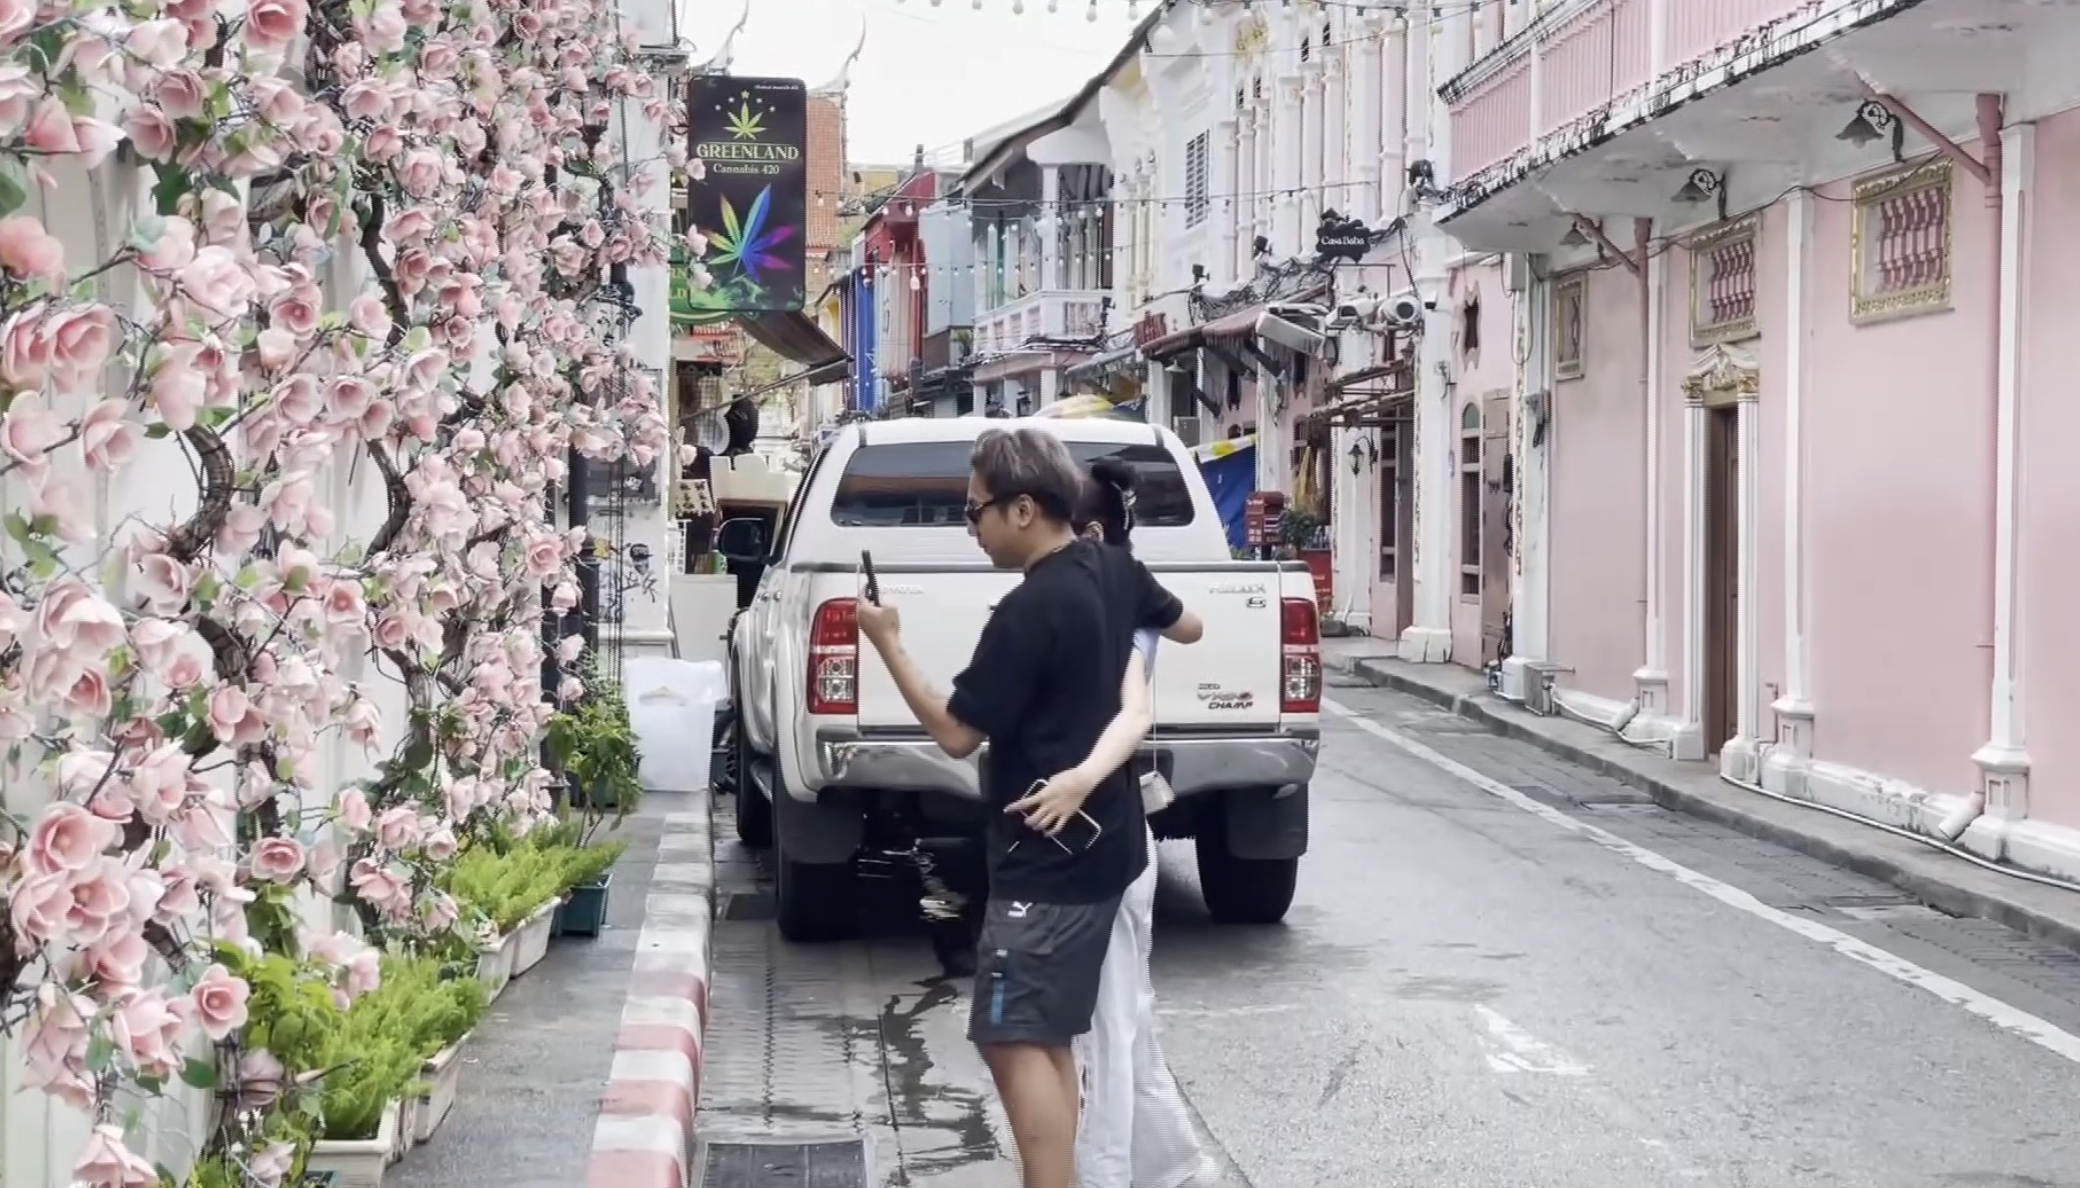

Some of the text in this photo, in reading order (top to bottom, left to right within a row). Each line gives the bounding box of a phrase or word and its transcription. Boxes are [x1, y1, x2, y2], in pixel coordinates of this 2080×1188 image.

[696, 143, 800, 160] GREENLAND
[712, 162, 781, 175] Cannabis 420
[1320, 236, 1342, 245] Casa
[1207, 700, 1254, 710] CHAMP
